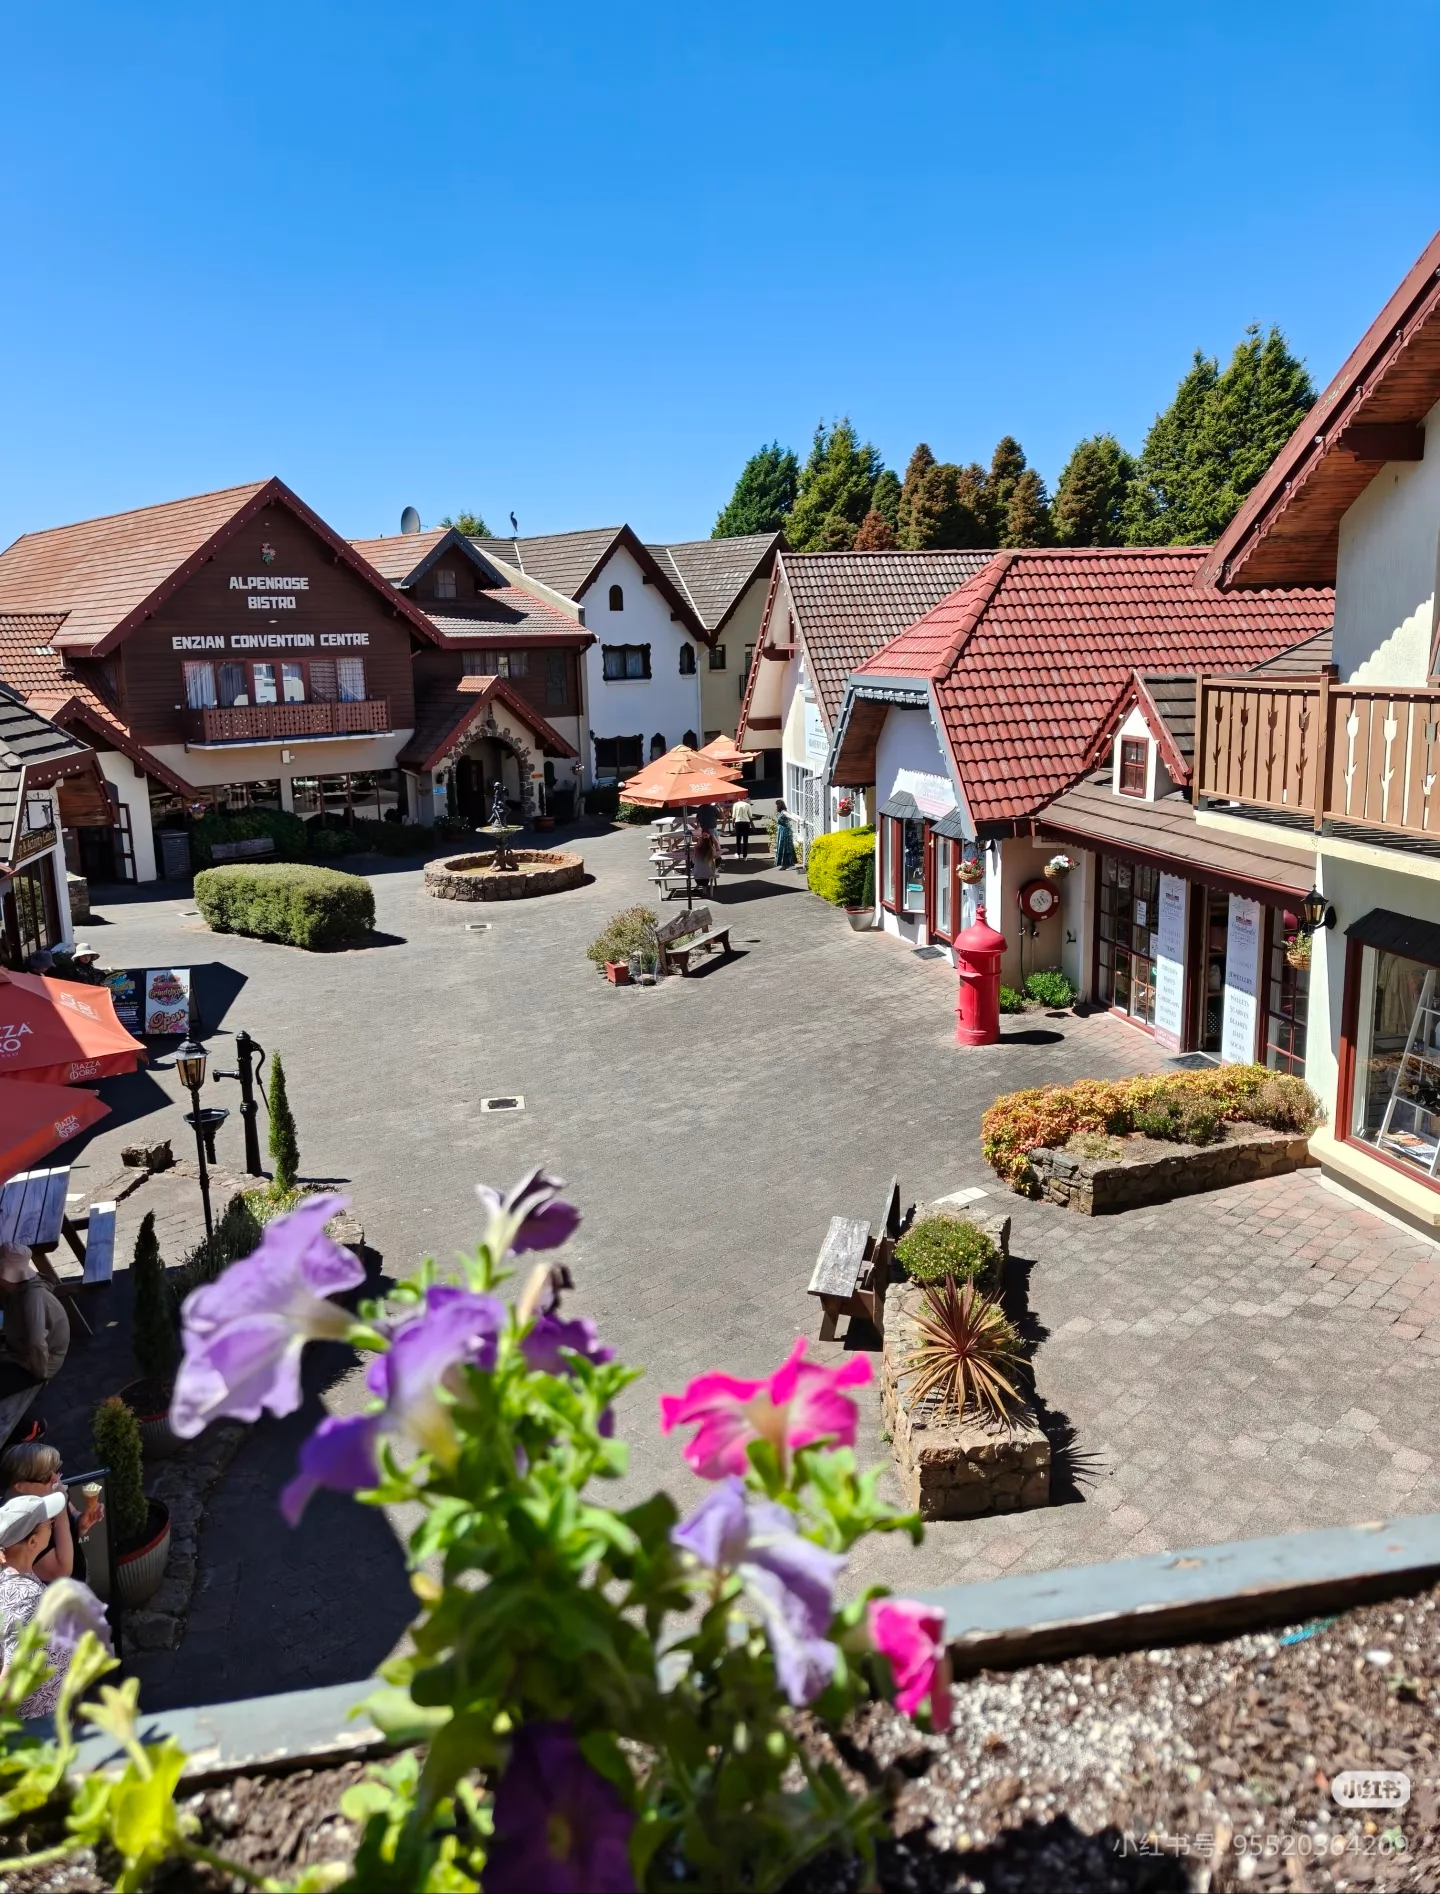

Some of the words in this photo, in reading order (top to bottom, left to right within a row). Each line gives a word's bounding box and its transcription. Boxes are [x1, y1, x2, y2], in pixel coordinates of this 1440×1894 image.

[229, 576, 310, 590] ALPENROSE
[247, 596, 297, 609] BISTRO
[171, 635, 225, 650] ENZIAN
[230, 634, 315, 648] CONVENTION
[319, 632, 370, 646] CENTRE
[1229, 1005, 1249, 1018] SCARVES
[71, 1060, 101, 1072] PIAZZA
[54, 1114, 78, 1131] PIAZZA
